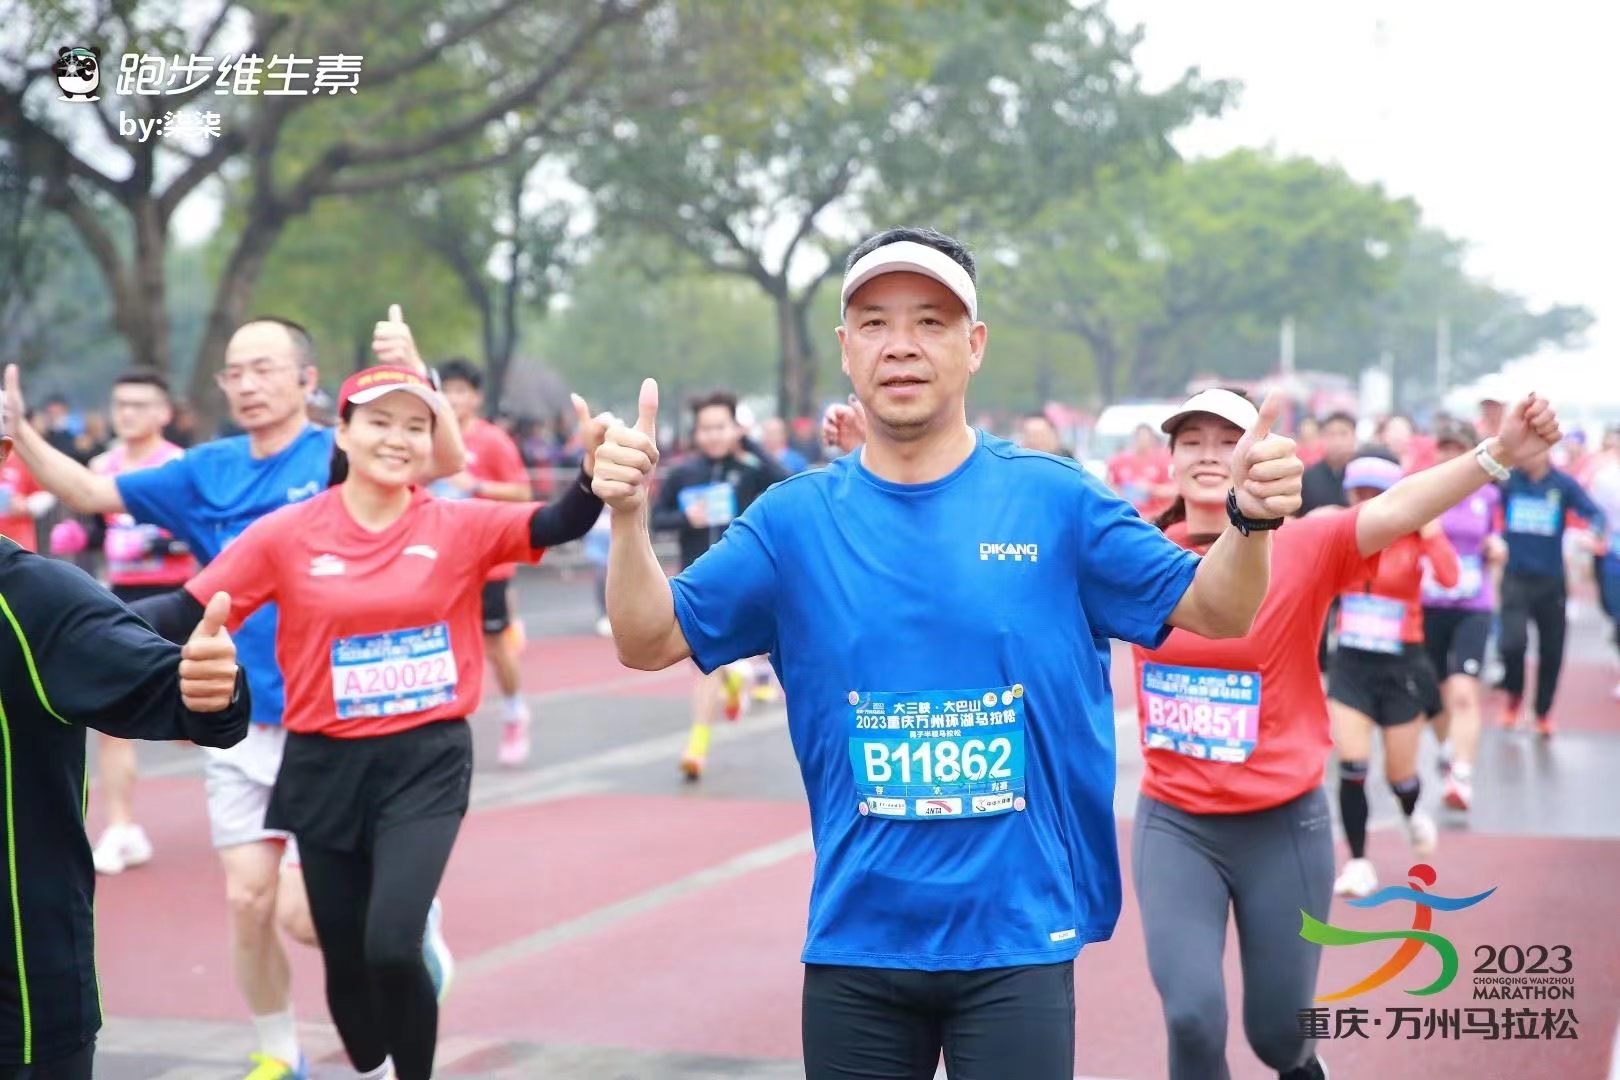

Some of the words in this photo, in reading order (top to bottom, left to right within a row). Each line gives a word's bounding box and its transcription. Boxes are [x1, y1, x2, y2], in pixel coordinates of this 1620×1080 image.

[345, 657, 448, 695] A20022
[856, 710, 1016, 729] 2023重庆万州环湖马拉松
[1148, 695, 1247, 739] B20851
[863, 737, 1012, 783] B11862
